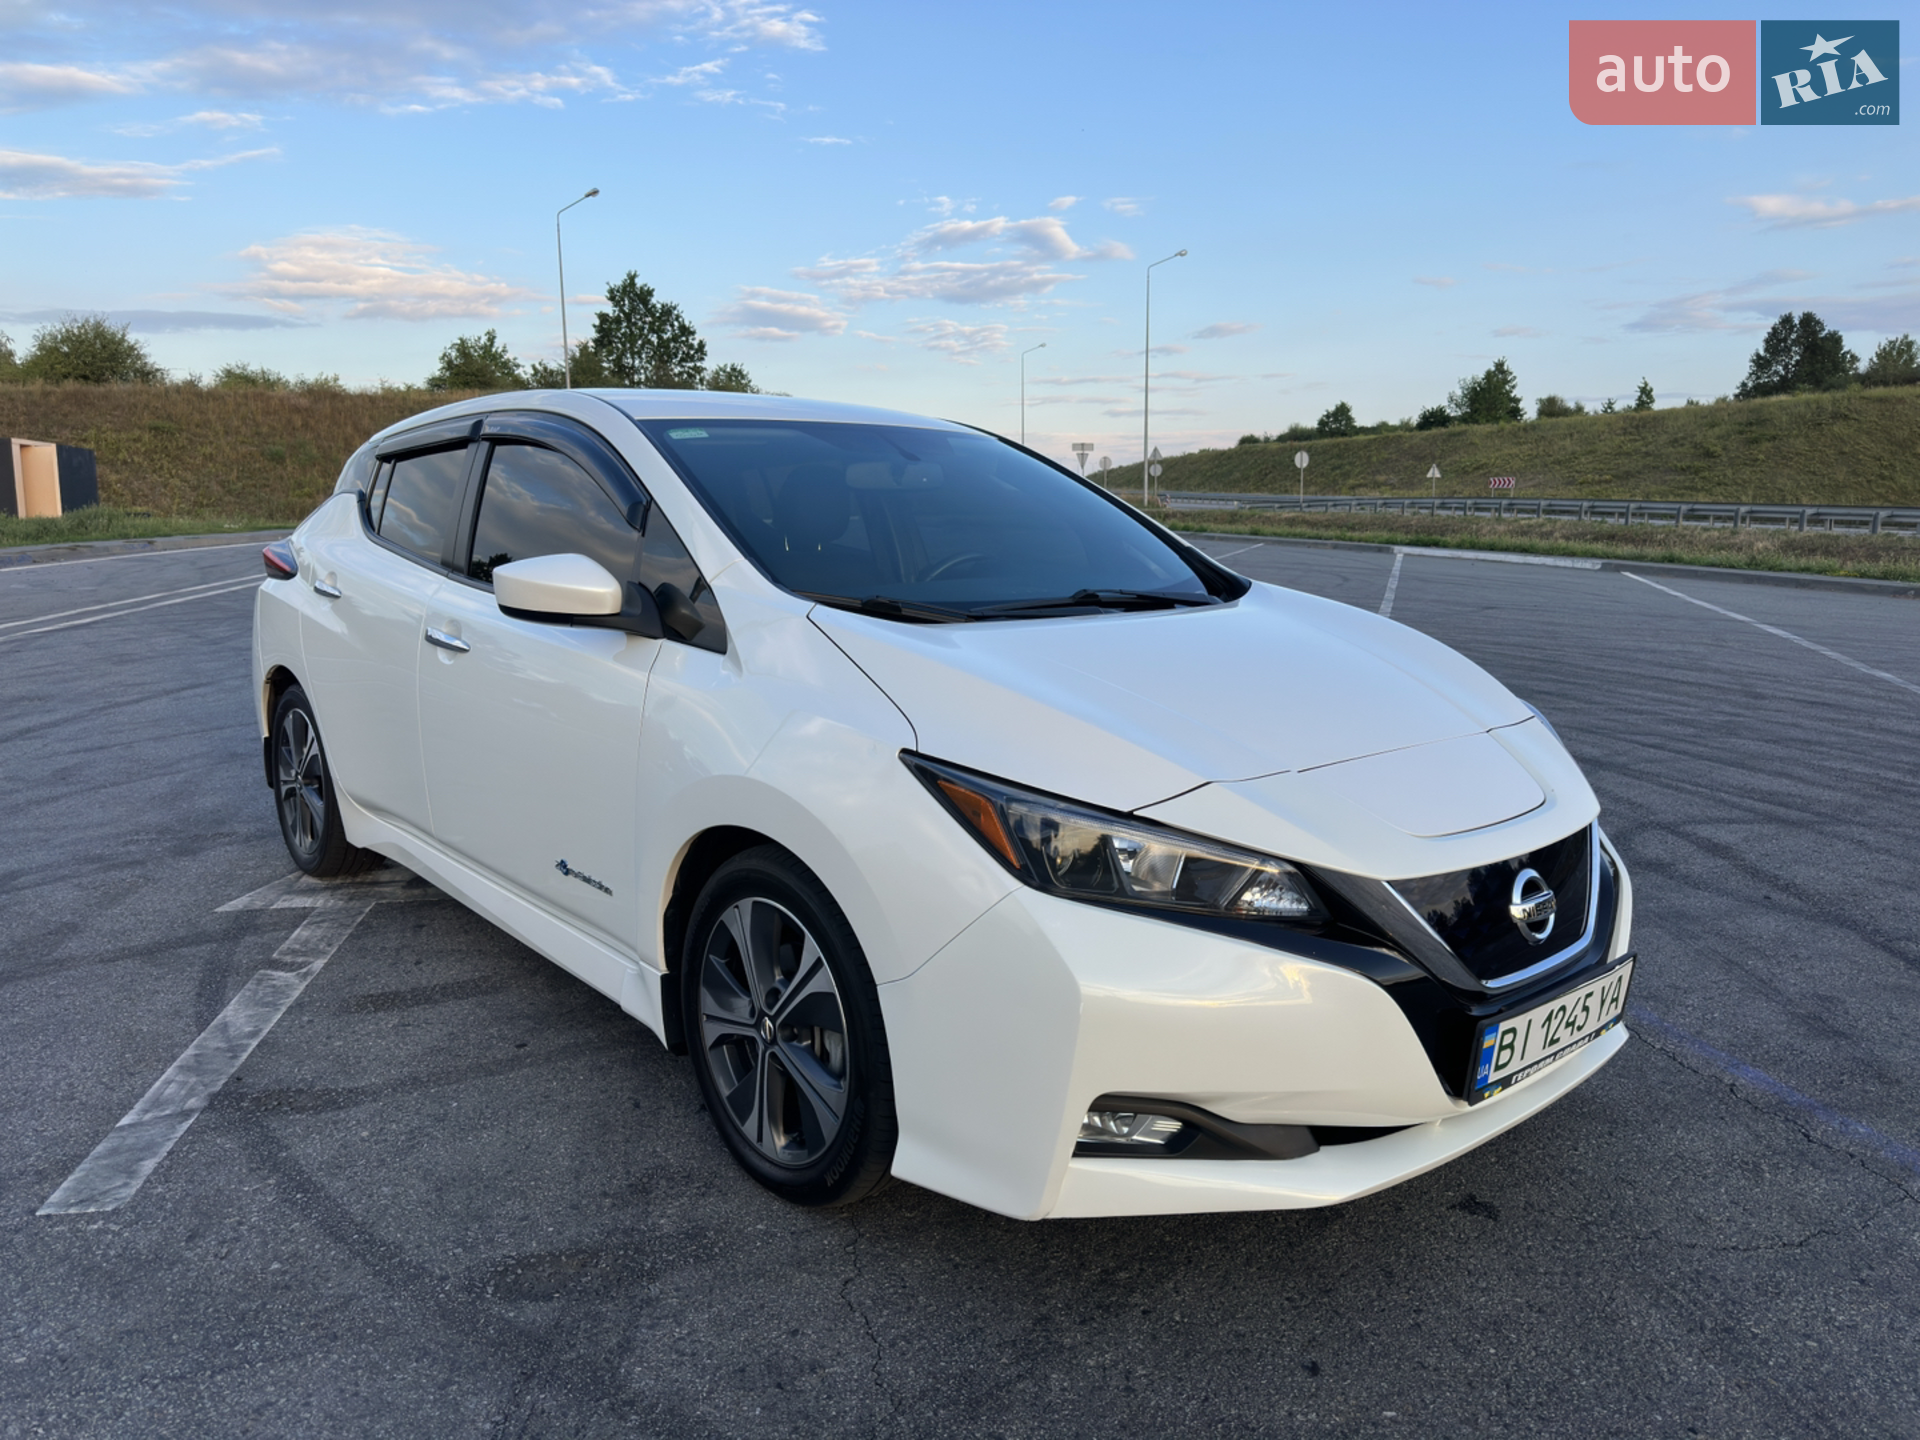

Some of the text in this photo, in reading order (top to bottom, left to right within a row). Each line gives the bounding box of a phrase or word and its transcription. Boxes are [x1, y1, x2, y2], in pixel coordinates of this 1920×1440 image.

[1493, 1018, 1533, 1073] BI
[1541, 991, 1595, 1051] 1245
[1597, 974, 1623, 1023] YA
[1477, 1063, 1489, 1080] UA
